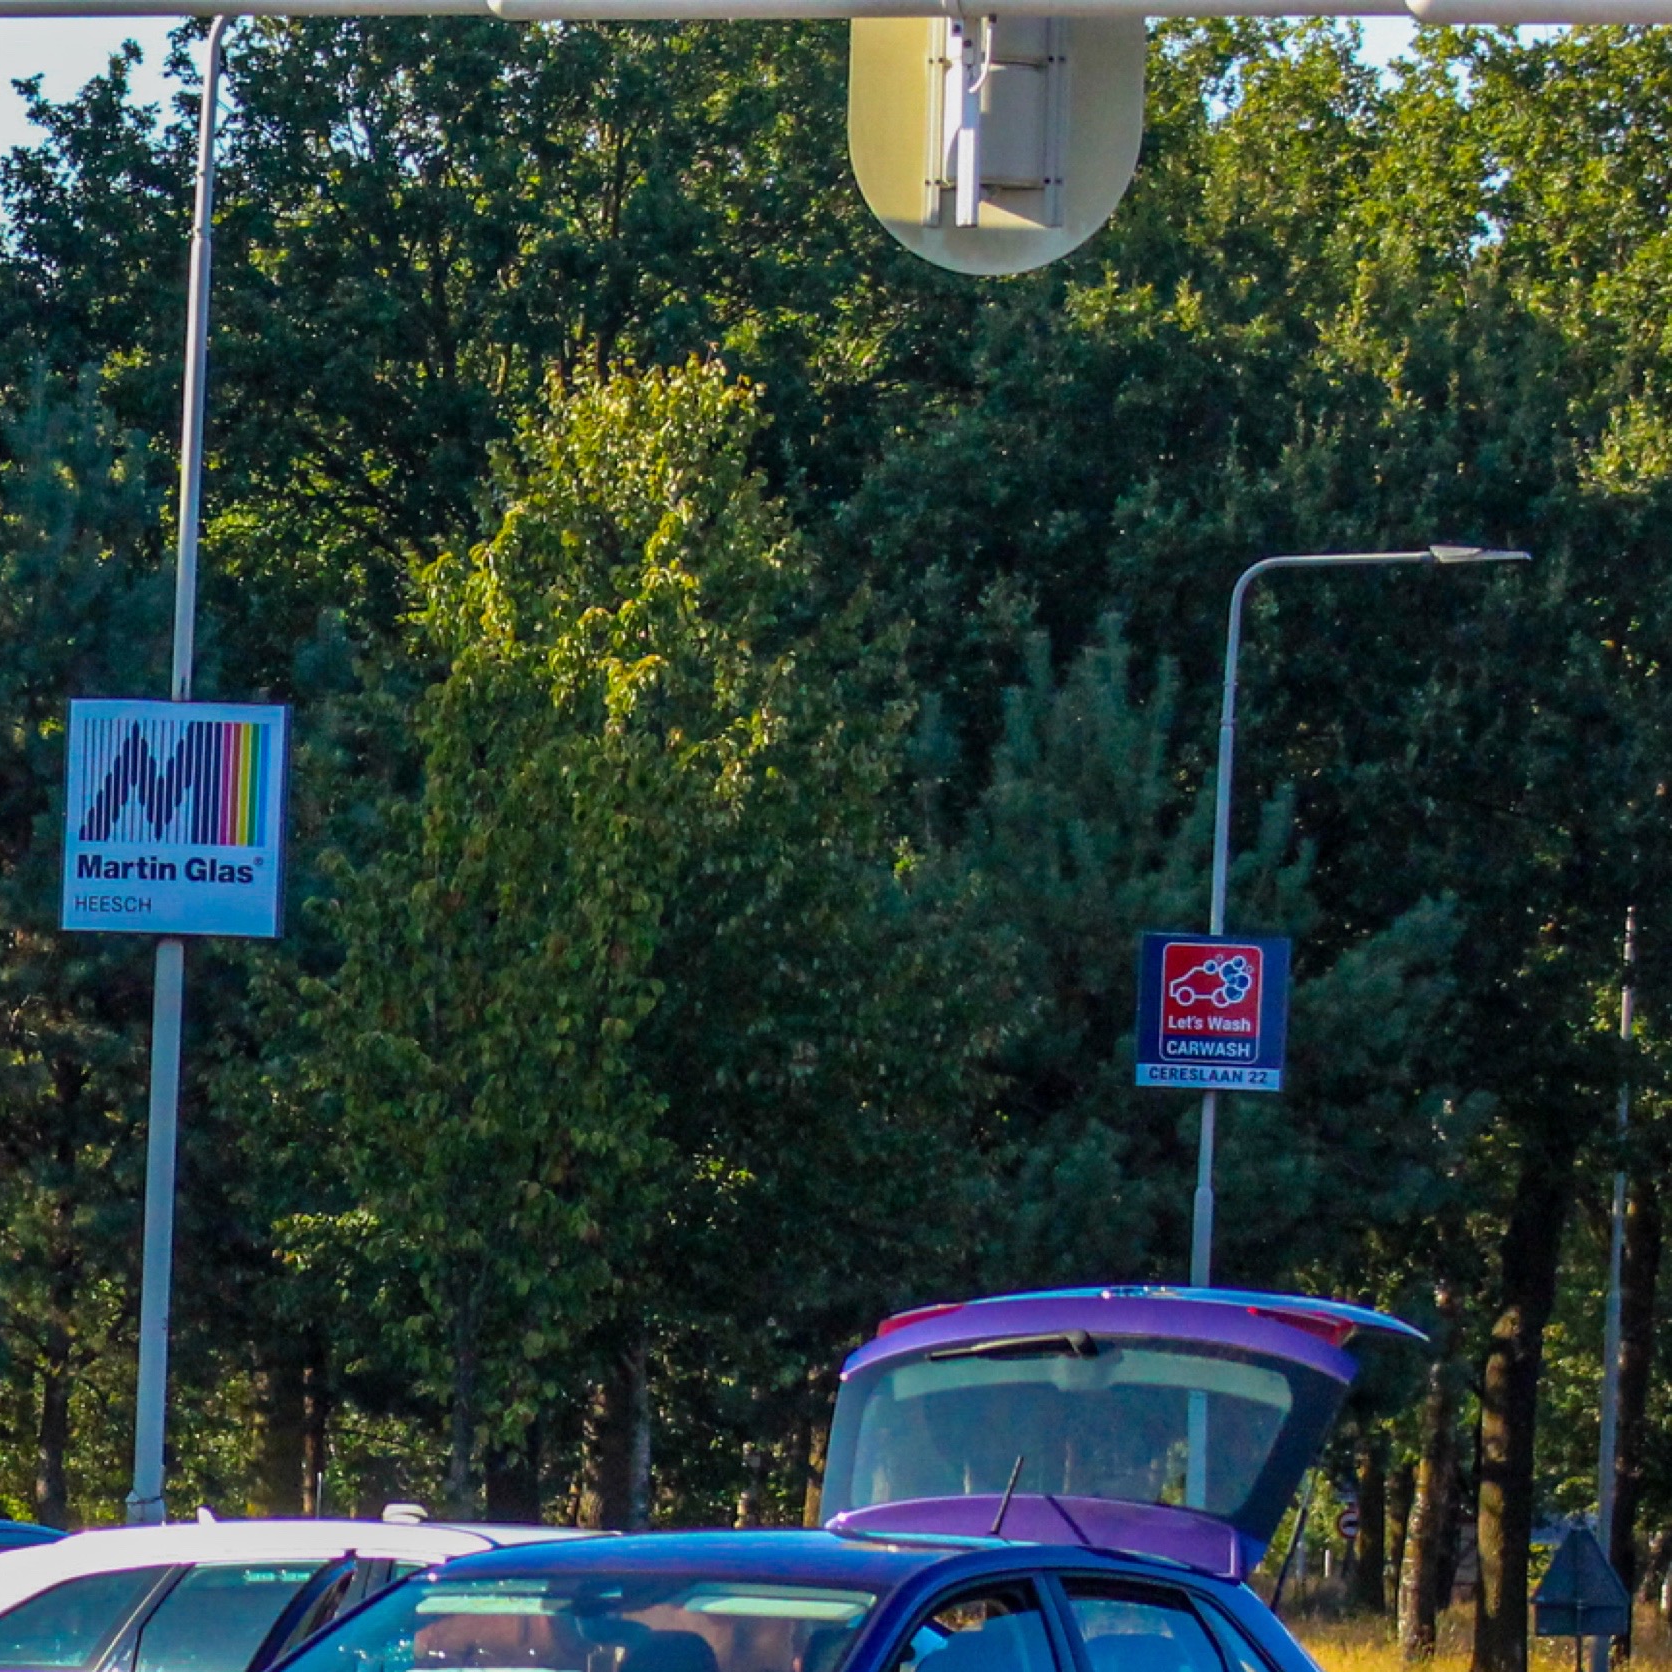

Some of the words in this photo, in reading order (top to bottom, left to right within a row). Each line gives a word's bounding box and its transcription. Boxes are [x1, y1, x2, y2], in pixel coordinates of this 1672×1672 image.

[77, 855, 176, 880] Martin
[75, 896, 152, 913] HEESCH
[1168, 1015, 1203, 1030] Let's
[1208, 1016, 1251, 1032] Wash
[1166, 1040, 1251, 1057] CARWASH
[1149, 1067, 1243, 1083] CERESLAAN
[1248, 1072, 1268, 1083] 22
